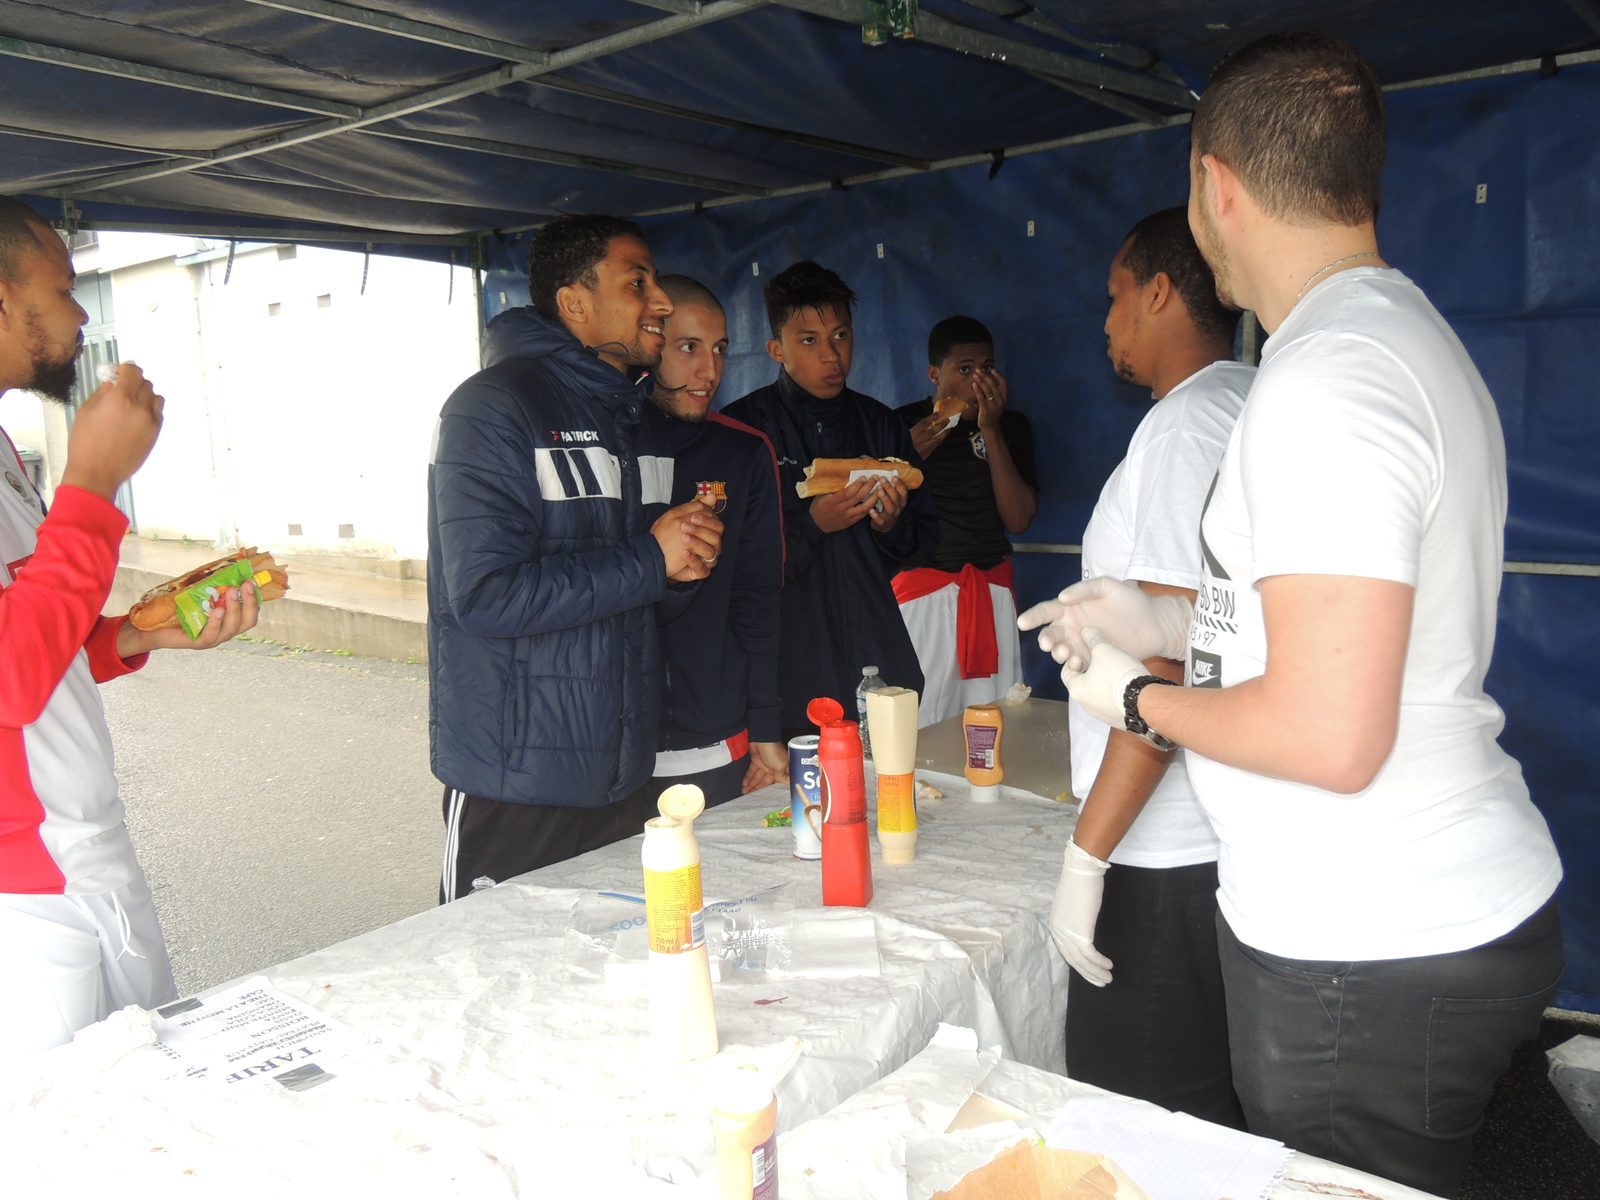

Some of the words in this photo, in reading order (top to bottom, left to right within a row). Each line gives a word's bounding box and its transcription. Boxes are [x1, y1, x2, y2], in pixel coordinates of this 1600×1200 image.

[1212, 586, 1235, 619] BW
[1203, 631, 1217, 647] 97
[1194, 659, 1214, 677] NIKE
[263, 1008, 297, 1022] FANTA
[249, 1015, 309, 1038] BOISSON
[276, 1028, 333, 1050] SANDWICH
[226, 1046, 322, 1084] TARIF
